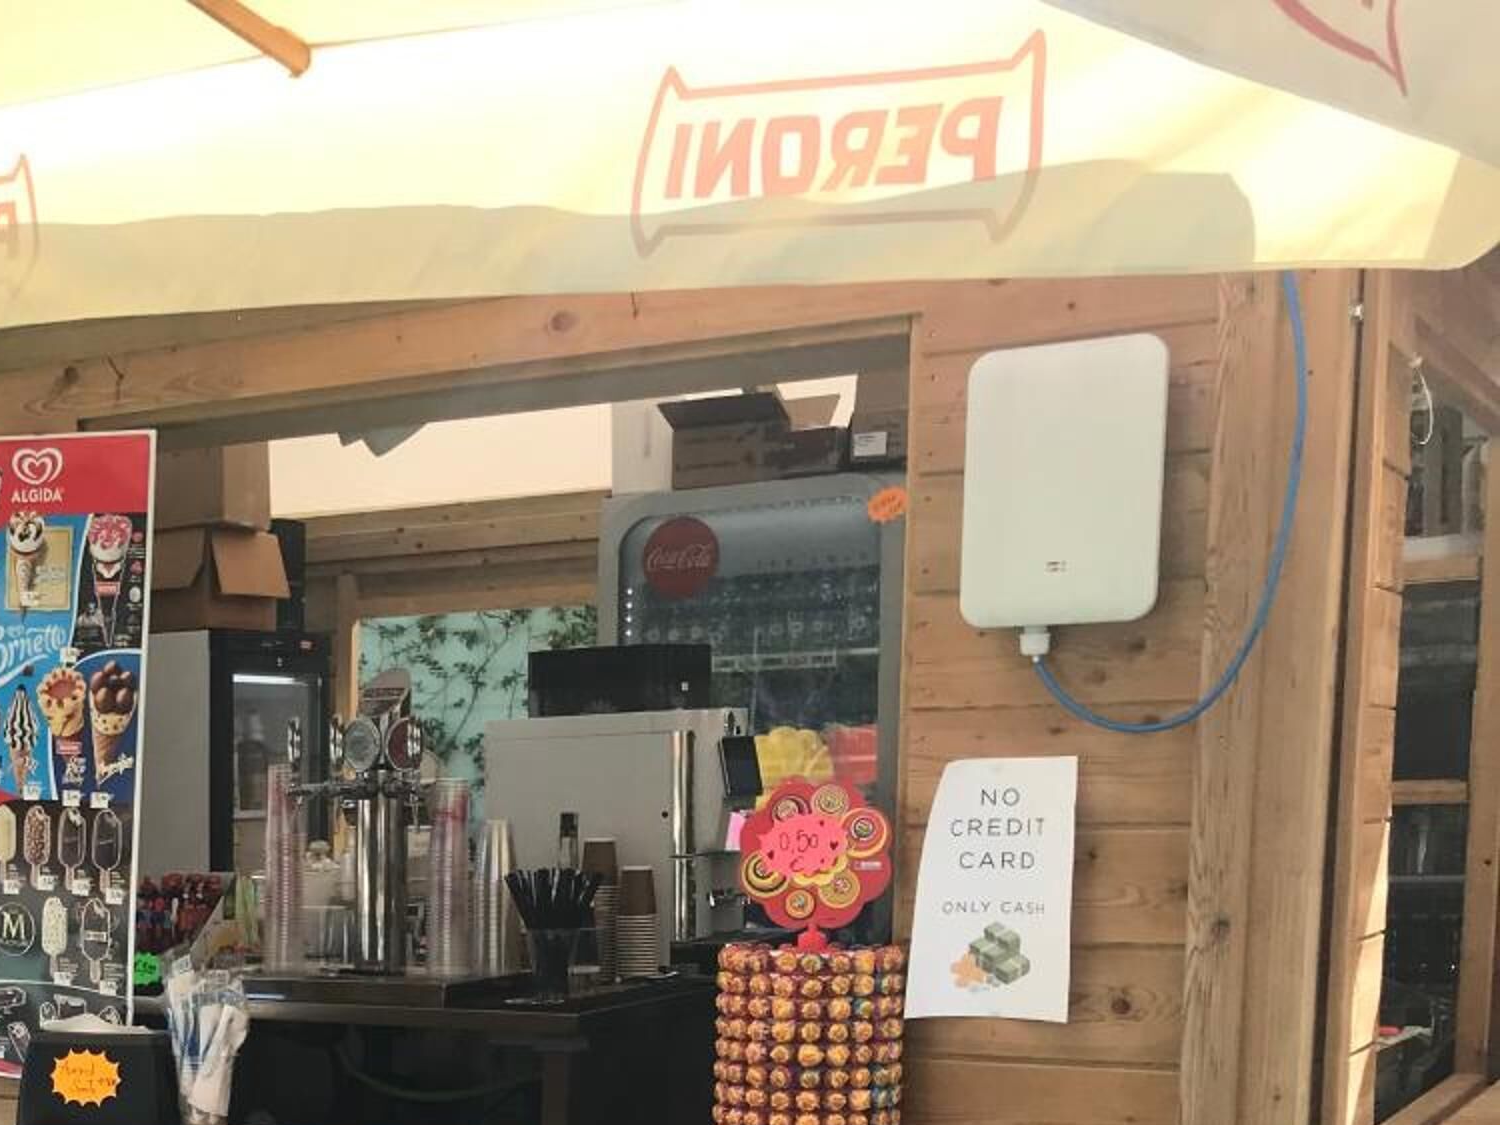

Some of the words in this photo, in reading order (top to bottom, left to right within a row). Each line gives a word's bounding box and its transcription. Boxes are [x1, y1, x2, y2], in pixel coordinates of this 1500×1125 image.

[11, 488, 62, 503] ALGIDA
[981, 787, 1021, 806] NO
[950, 818, 1045, 837] CREDIT
[960, 851, 1035, 870] CARD
[942, 901, 990, 915] ONLY
[1000, 901, 1045, 915] CASH
